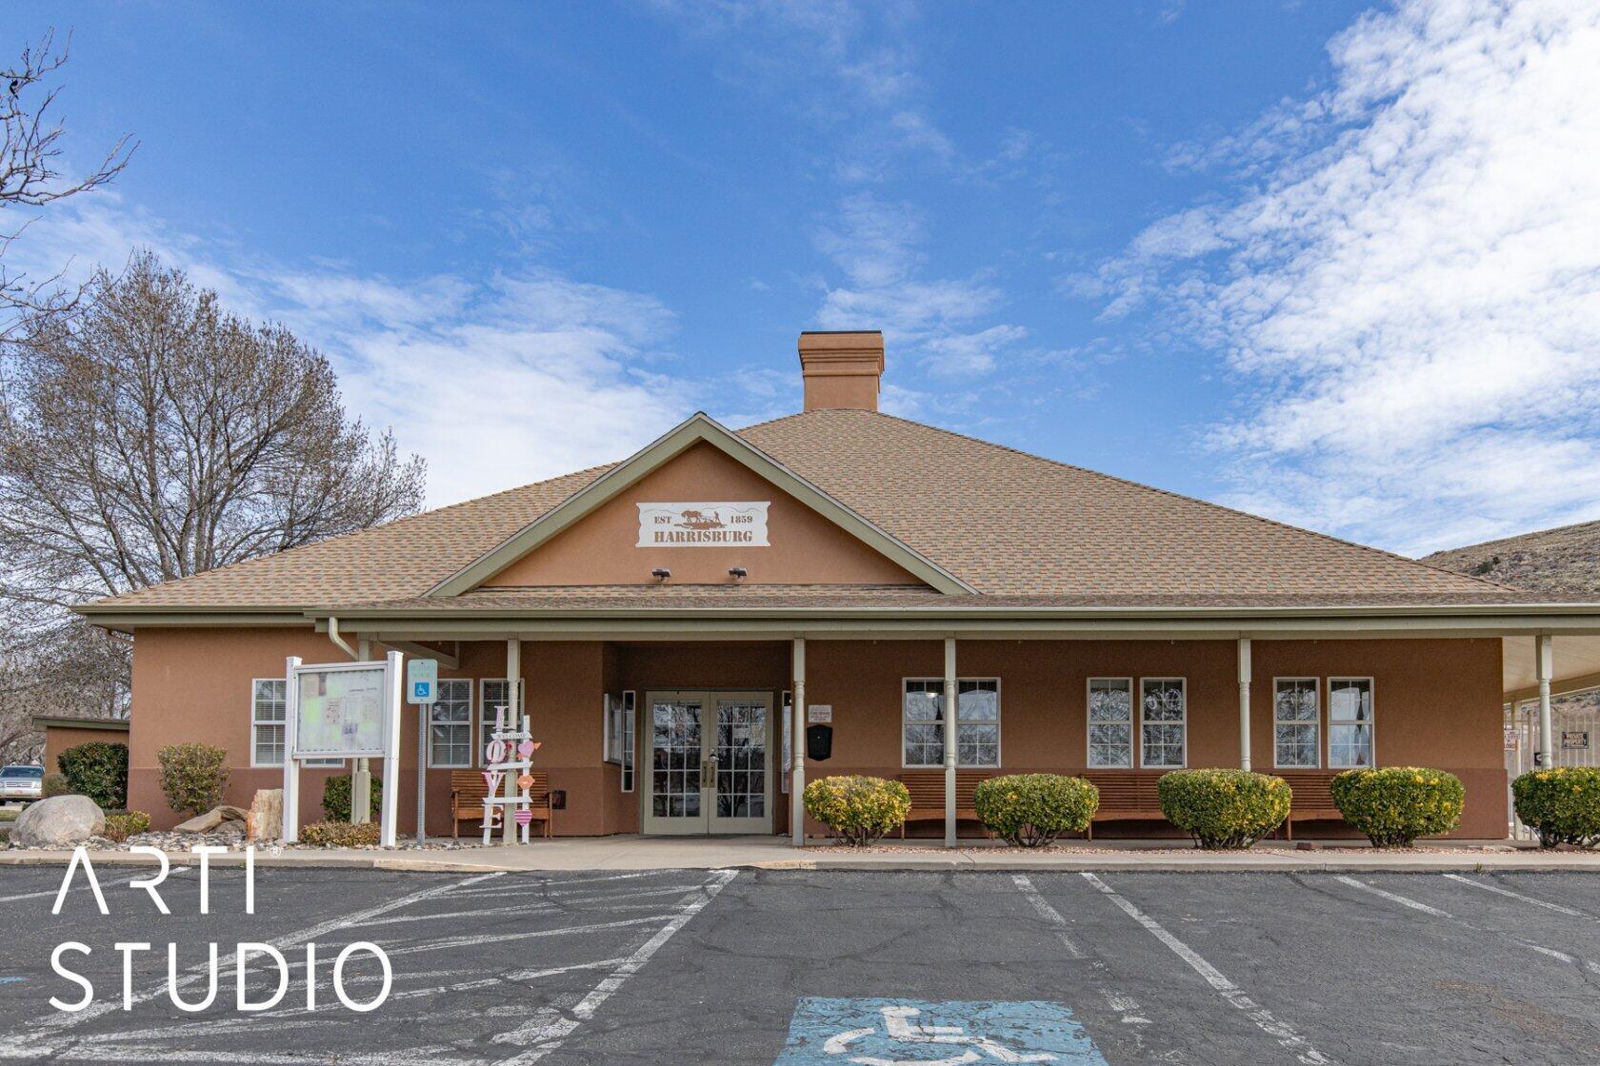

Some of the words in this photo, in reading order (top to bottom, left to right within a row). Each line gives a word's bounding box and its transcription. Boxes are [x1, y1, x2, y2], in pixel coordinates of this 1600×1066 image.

[654, 516, 672, 524] EST
[730, 515, 753, 524] 1859
[654, 530, 753, 543] HARRISBURG
